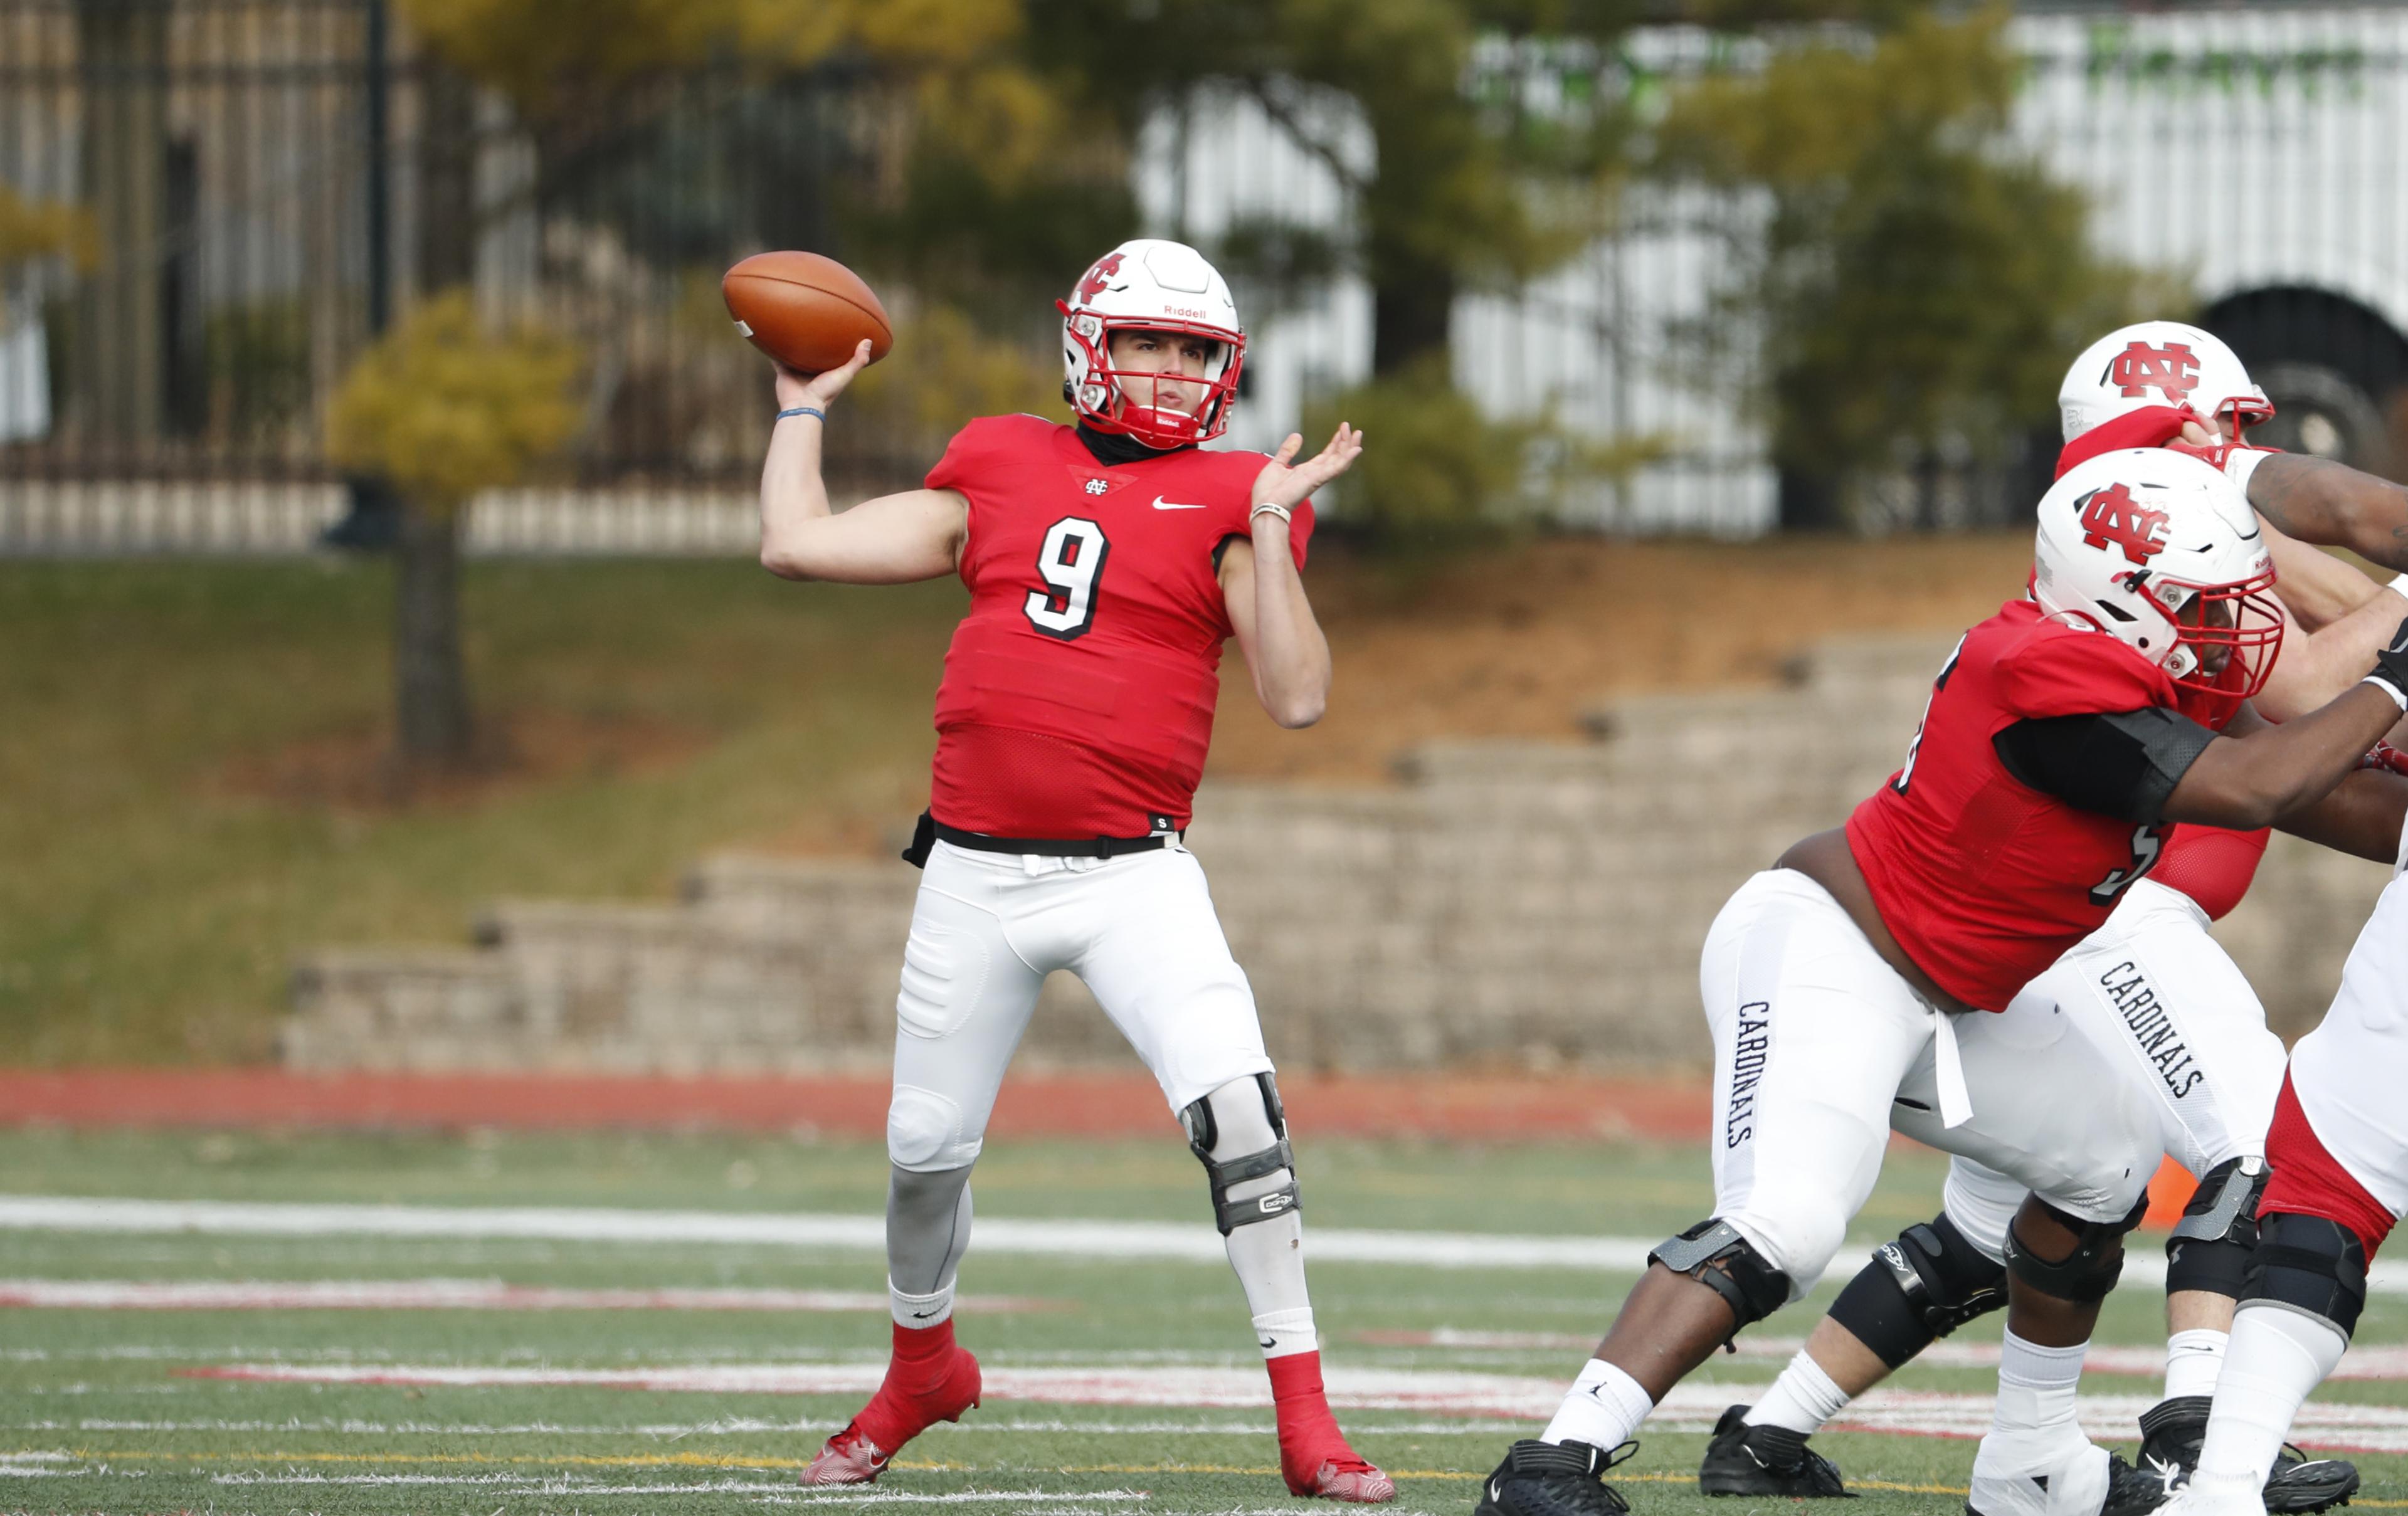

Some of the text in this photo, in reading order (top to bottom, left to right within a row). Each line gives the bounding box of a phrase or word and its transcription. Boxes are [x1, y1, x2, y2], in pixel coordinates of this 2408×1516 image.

[1164, 305, 1207, 319] Riddell
[1022, 515, 1111, 642] 9
[1728, 1001, 1770, 1149] CARDINALS
[2100, 961, 2204, 1099] CARDINALS
